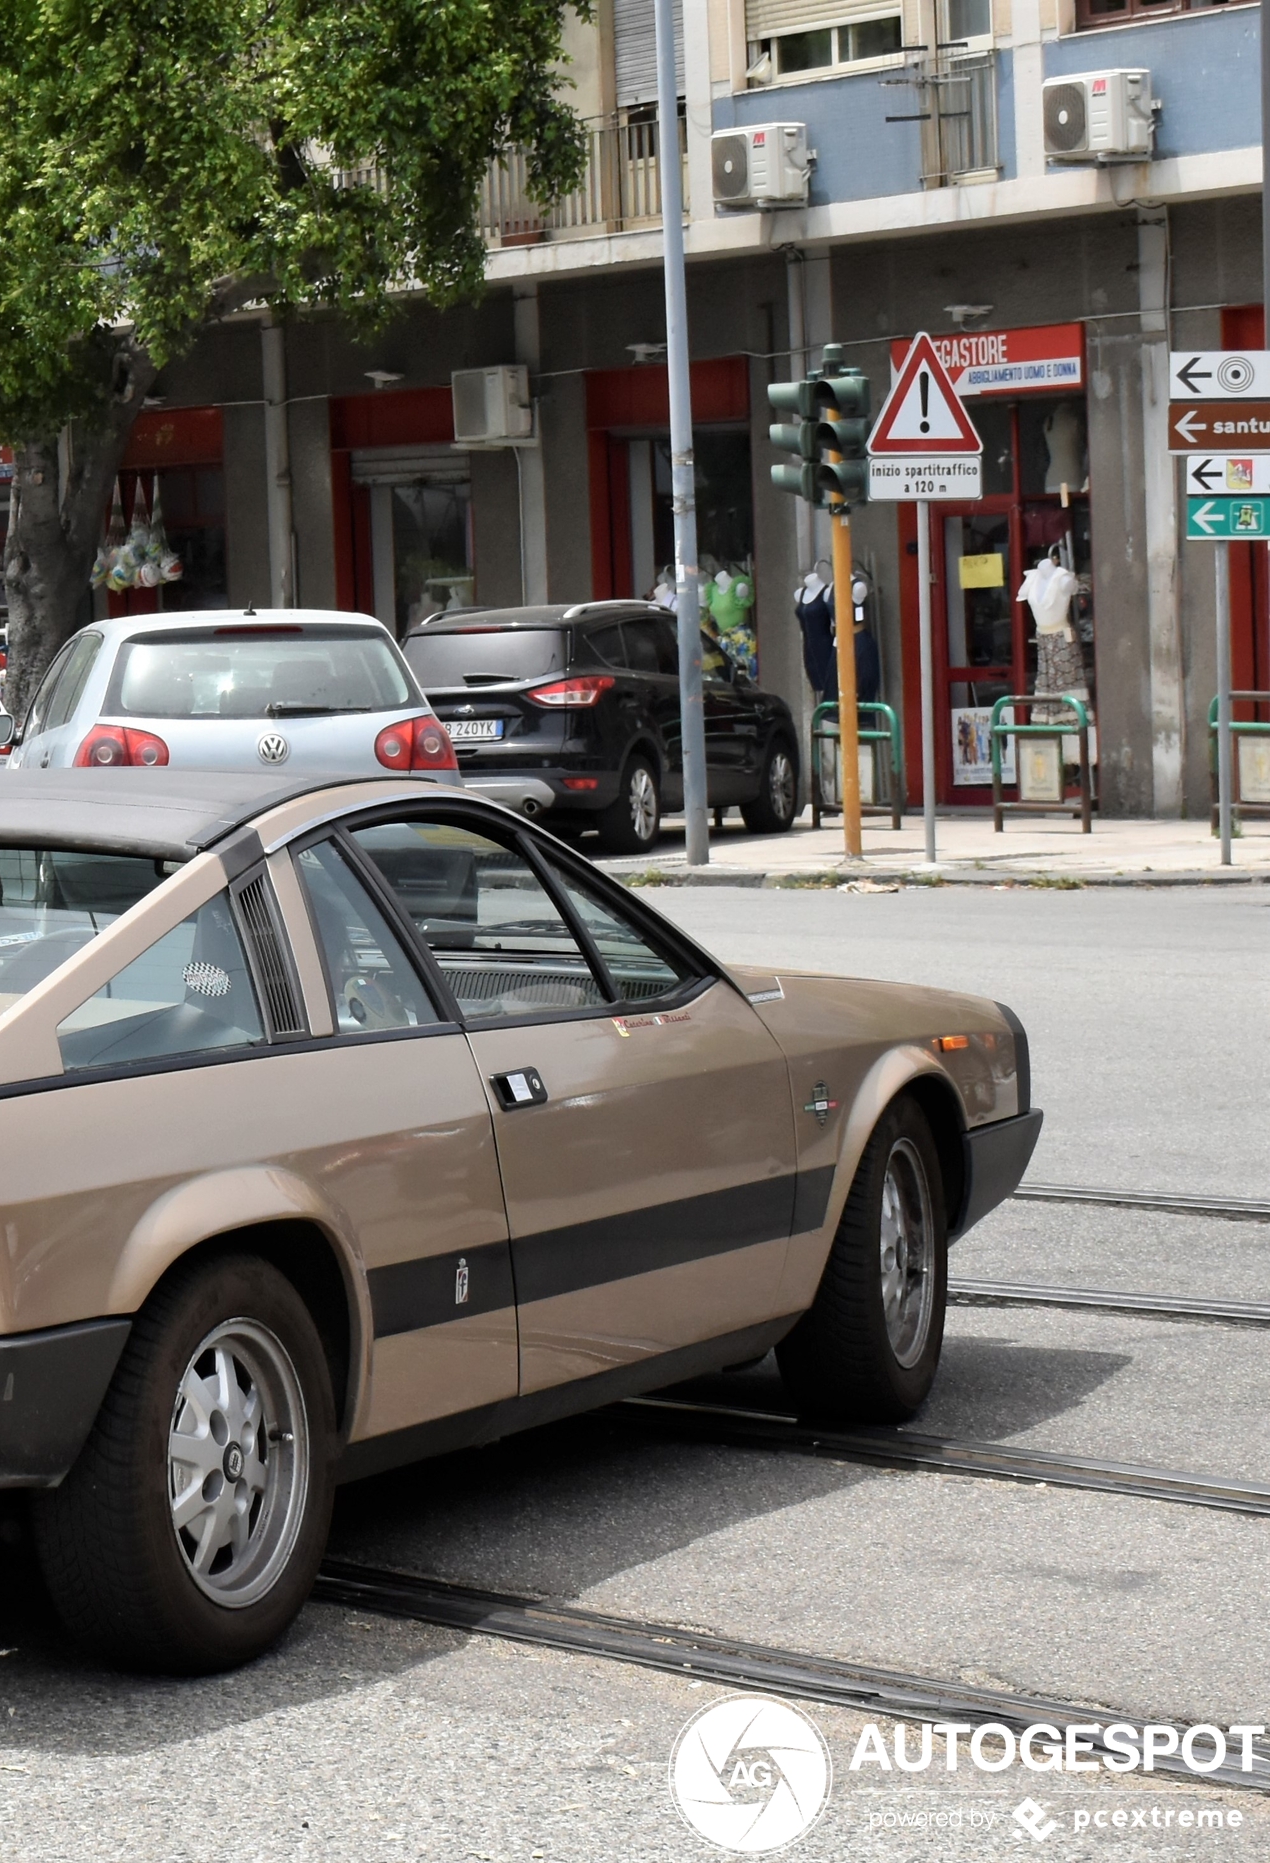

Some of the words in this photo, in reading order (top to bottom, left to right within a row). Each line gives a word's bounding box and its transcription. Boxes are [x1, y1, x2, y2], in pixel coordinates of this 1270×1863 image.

[968, 367, 1023, 385] ABBIGLIAMENTO
[1024, 365, 1045, 379] UOMO
[1046, 364, 1051, 377] E
[1053, 362, 1077, 377] DONNA
[872, 464, 901, 477] inizio
[905, 463, 978, 479] spartitraffico
[904, 484, 910, 493] a
[915, 481, 934, 493] 120
[939, 484, 947, 493] m
[456, 721, 494, 736] 240YK
